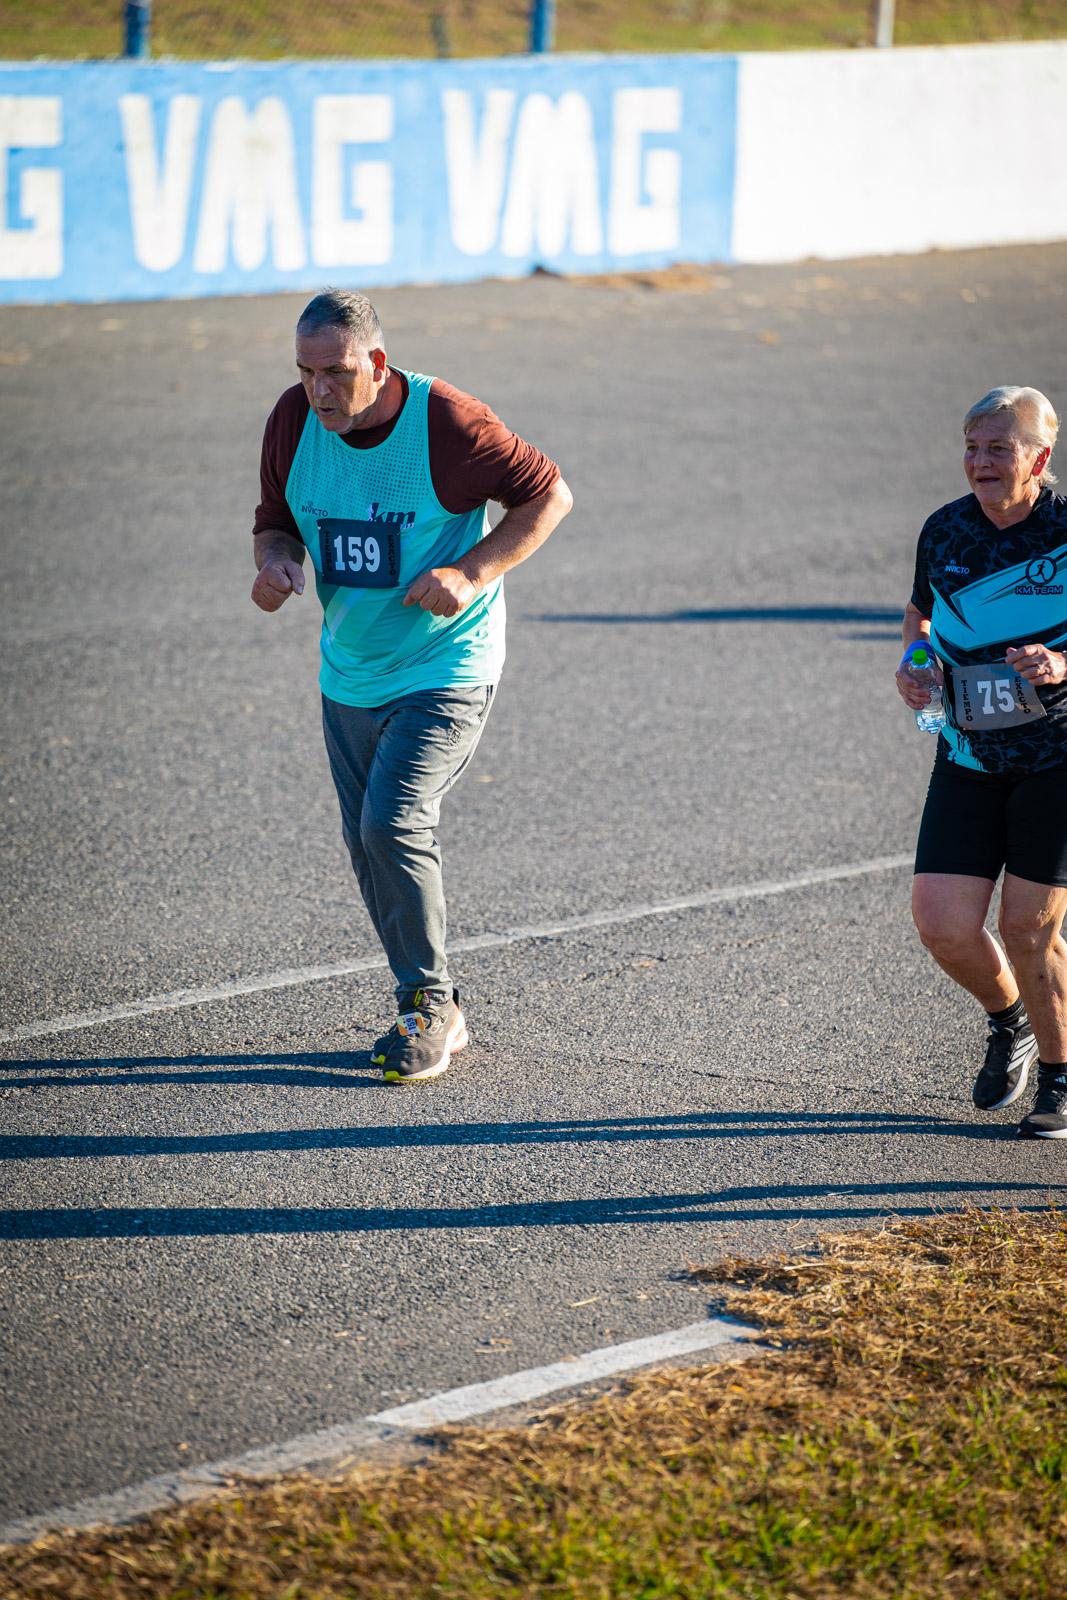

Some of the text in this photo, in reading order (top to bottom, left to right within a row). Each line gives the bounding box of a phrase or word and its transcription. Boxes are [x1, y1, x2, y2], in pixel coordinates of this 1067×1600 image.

[119, 93, 395, 274] VMG
[441, 88, 683, 258] VMG
[324, 531, 332, 572] TIEMPO
[334, 535, 381, 573] 159
[387, 534, 397, 576] EXACTO
[1034, 584, 1064, 595] TEAM
[960, 679, 974, 722] TIEMPO
[977, 678, 1015, 715] 75
[1014, 676, 1032, 714] EXACTO
